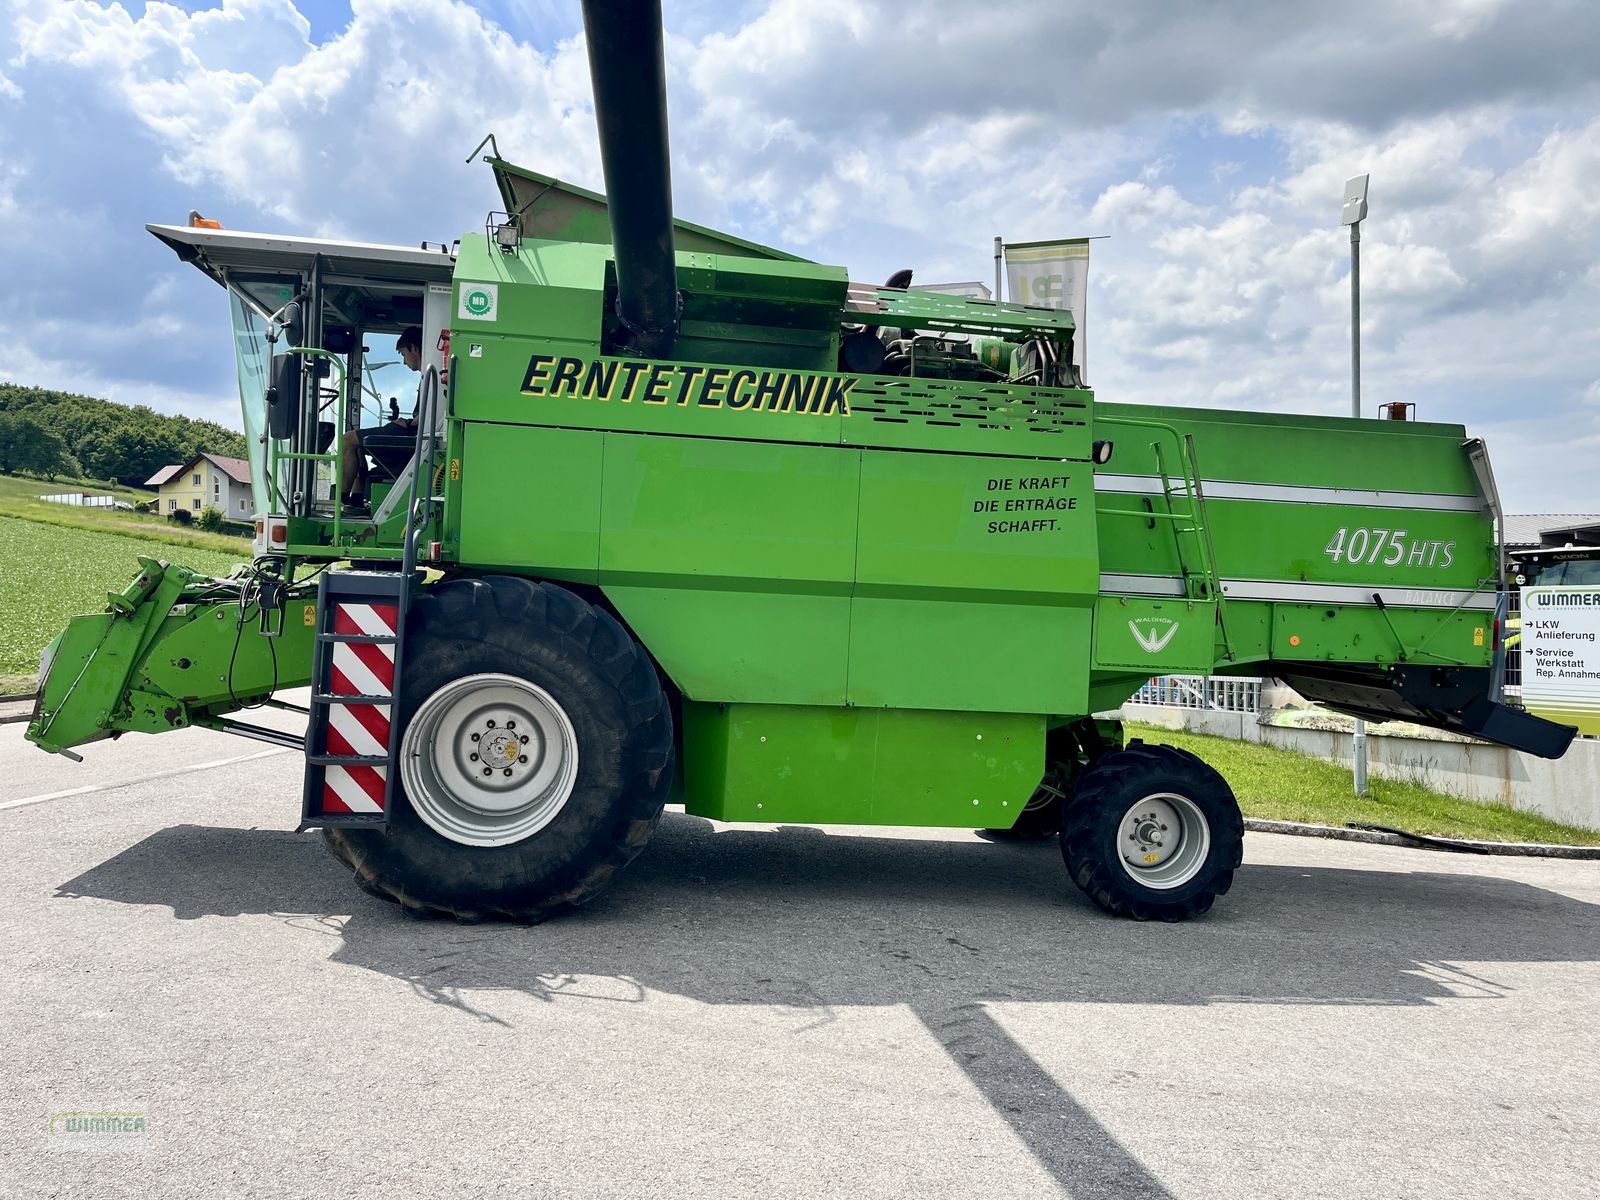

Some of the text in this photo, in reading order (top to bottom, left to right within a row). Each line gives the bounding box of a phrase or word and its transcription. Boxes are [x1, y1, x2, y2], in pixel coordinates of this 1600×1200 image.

[472, 296, 485, 306] MR
[520, 354, 860, 417] ERNTETECHNIK
[987, 476, 1070, 491] DIE KRAFT
[973, 496, 1077, 513] DIE ERTRÄGE
[987, 519, 1061, 534] SCHAFFT.
[1324, 527, 1456, 568] 4075 HTS
[1405, 590, 1456, 605] BALANCE
[1537, 593, 1600, 606] WIMMER
[1535, 620, 1560, 629] LKW
[1535, 630, 1595, 642] Anlieferung
[1535, 647, 1574, 657] Service
[1535, 658, 1585, 668] Werkstatt
[1536, 668, 1556, 679] Rep.
